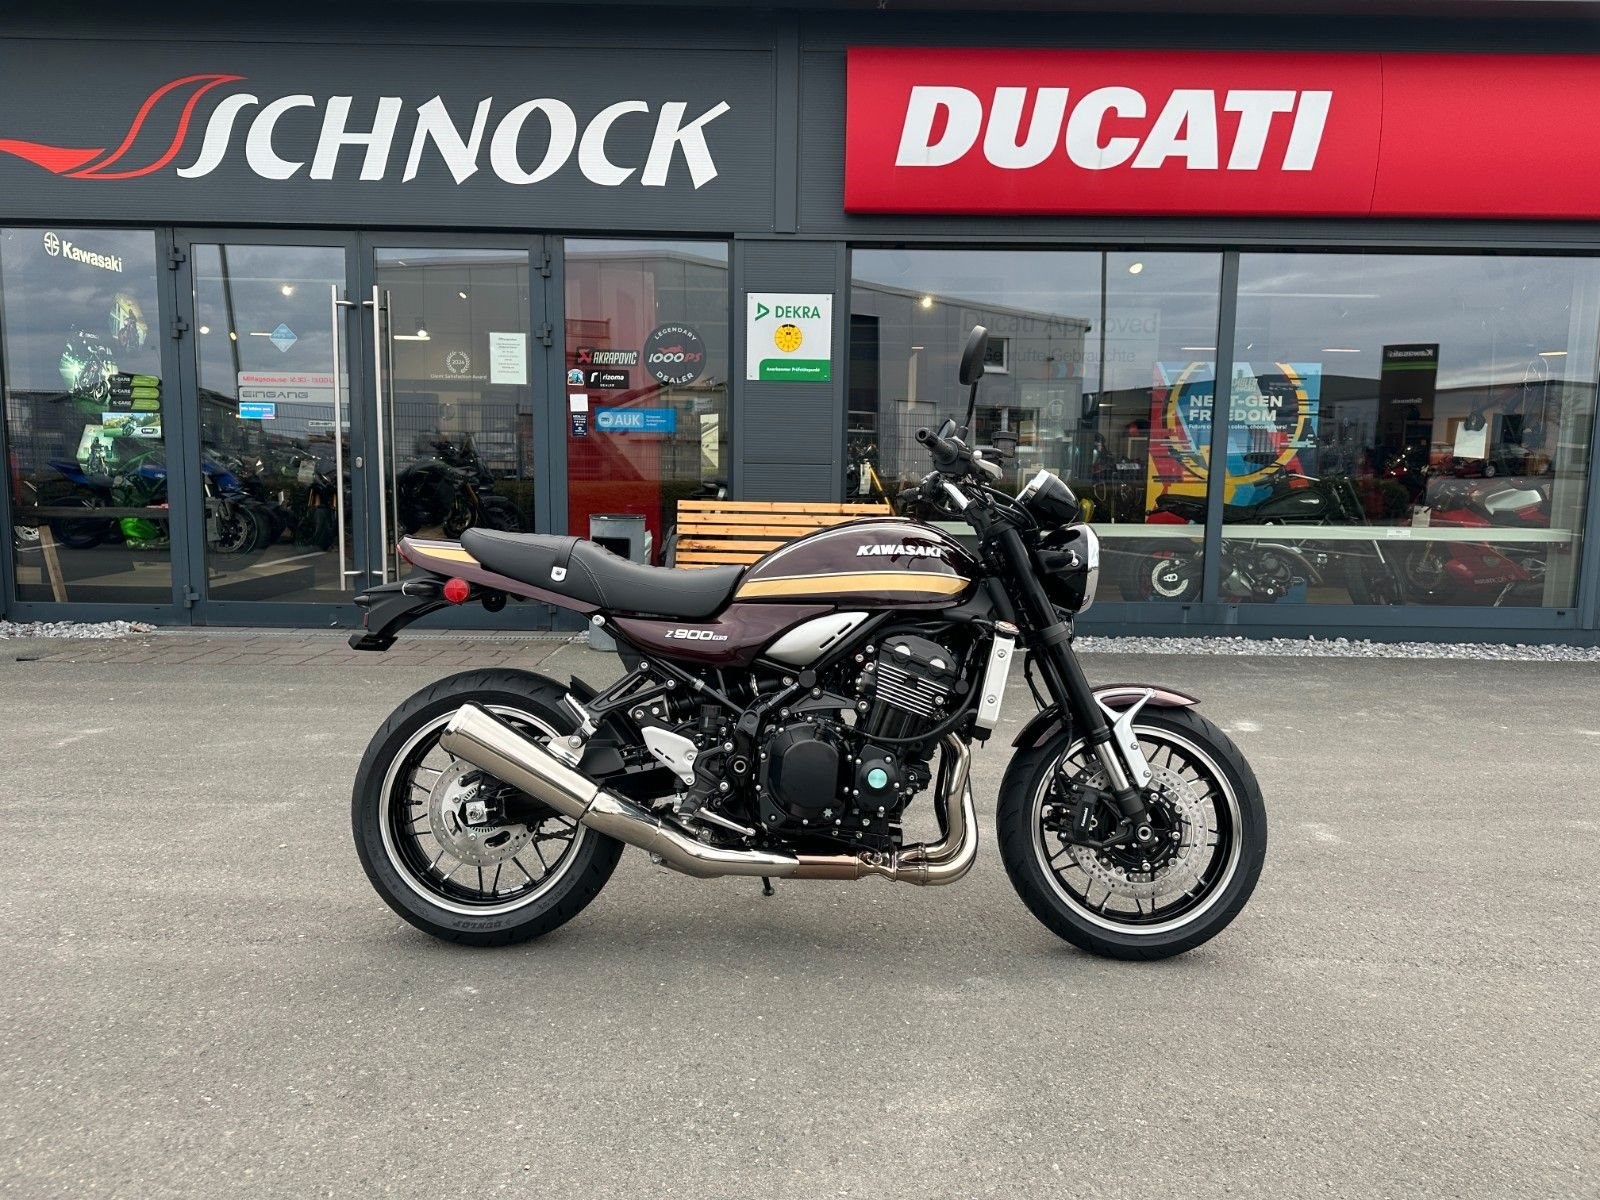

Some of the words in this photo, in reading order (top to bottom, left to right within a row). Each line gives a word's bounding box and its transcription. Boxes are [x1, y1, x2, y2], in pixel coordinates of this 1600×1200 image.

[895, 86, 1333, 171] DUCATI
[176, 92, 731, 190] SCHNOCK
[62, 240, 122, 272] Kawasaki
[775, 305, 821, 319] DEKRA
[654, 327, 697, 341] LEGENDARY
[655, 371, 695, 385] DEALER
[1189, 394, 1283, 408] NET-GEN
[614, 414, 640, 426] AUK
[1188, 408, 1277, 422] FREDOM
[856, 544, 942, 558] KAWASAKI
